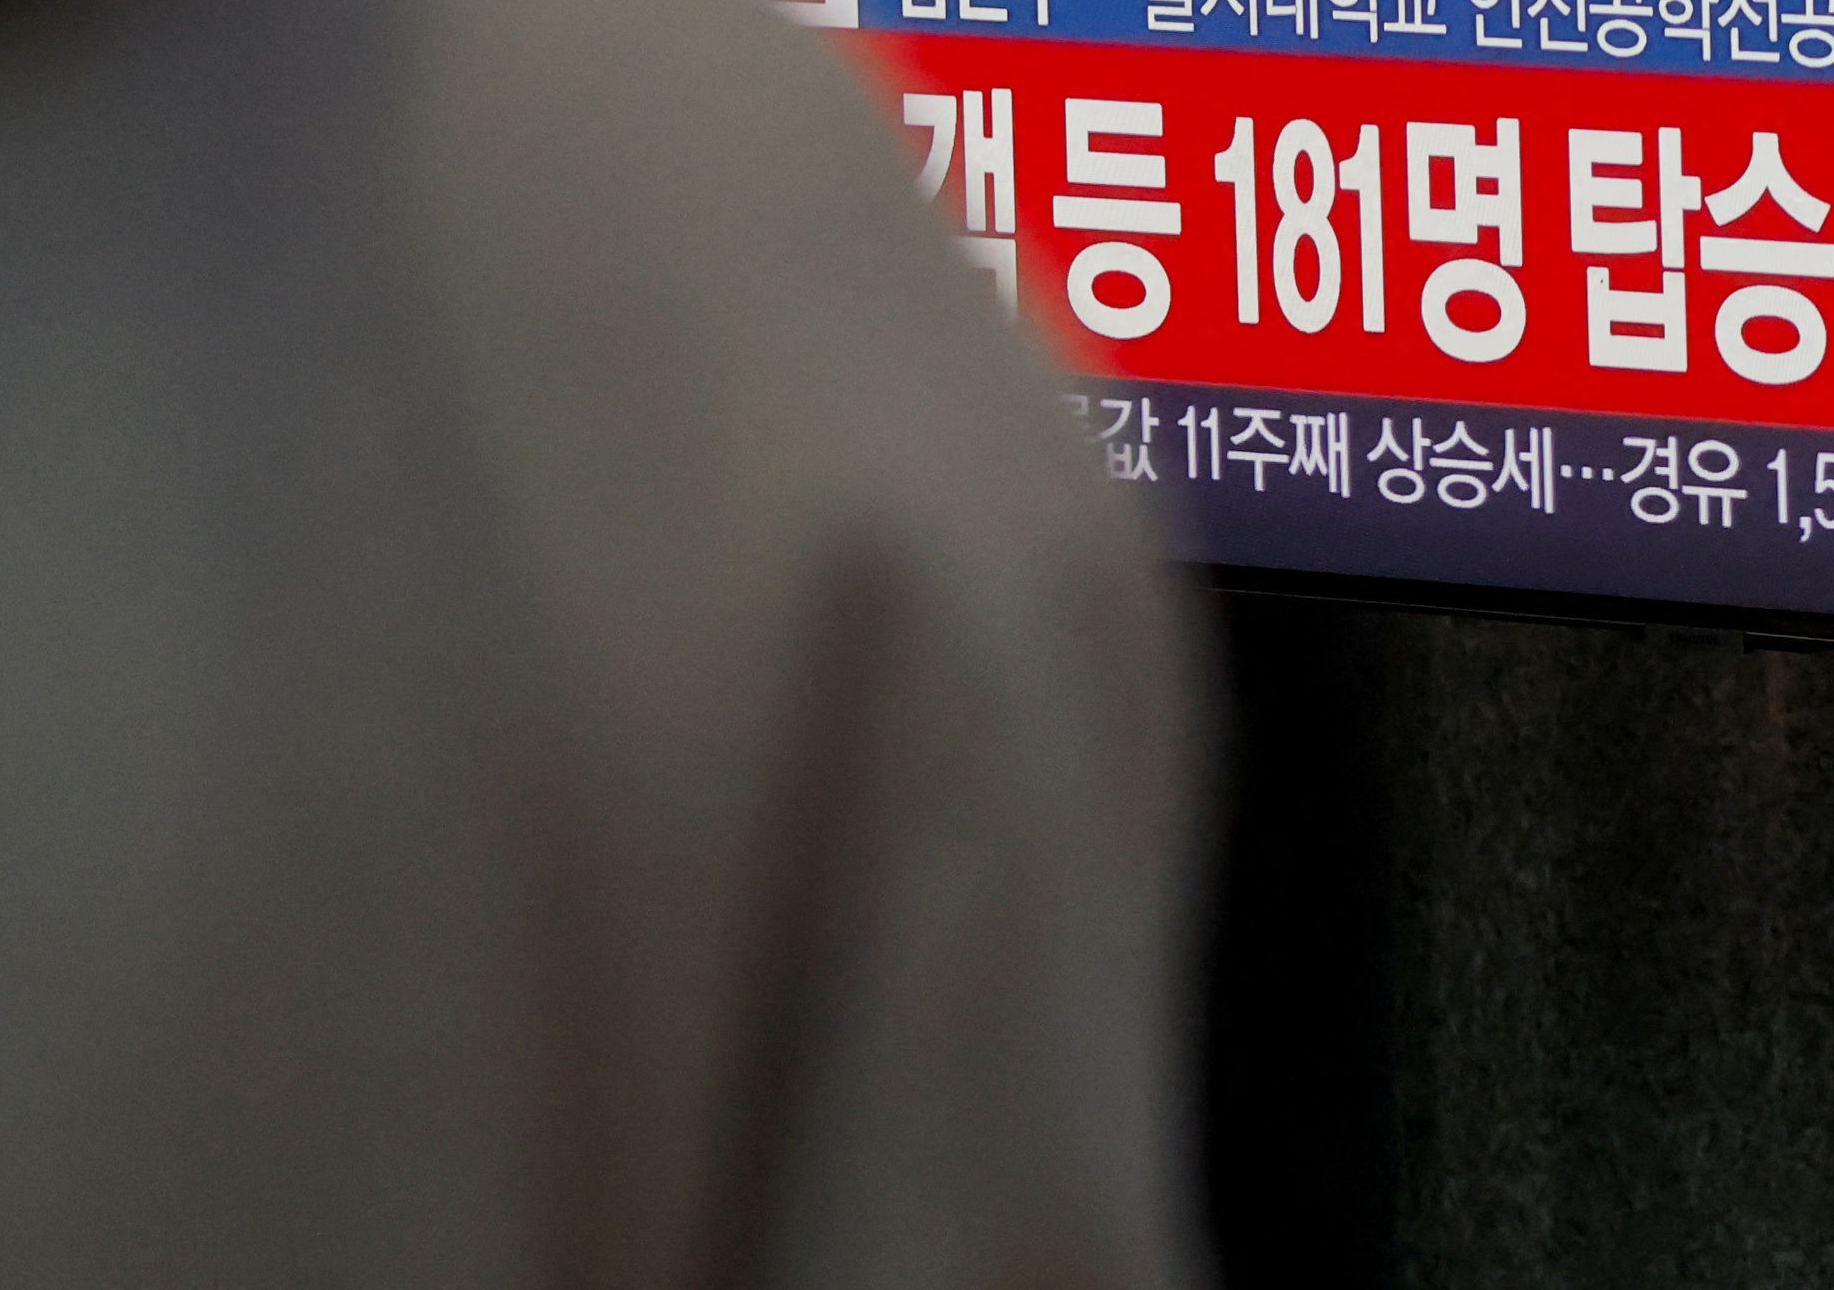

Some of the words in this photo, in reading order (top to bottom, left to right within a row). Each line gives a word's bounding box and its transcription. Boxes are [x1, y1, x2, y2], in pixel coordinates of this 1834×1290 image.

[1052, 97, 1181, 340] 등
[1214, 116, 1526, 363] 181명
[1178, 405, 1351, 498] 11주째
